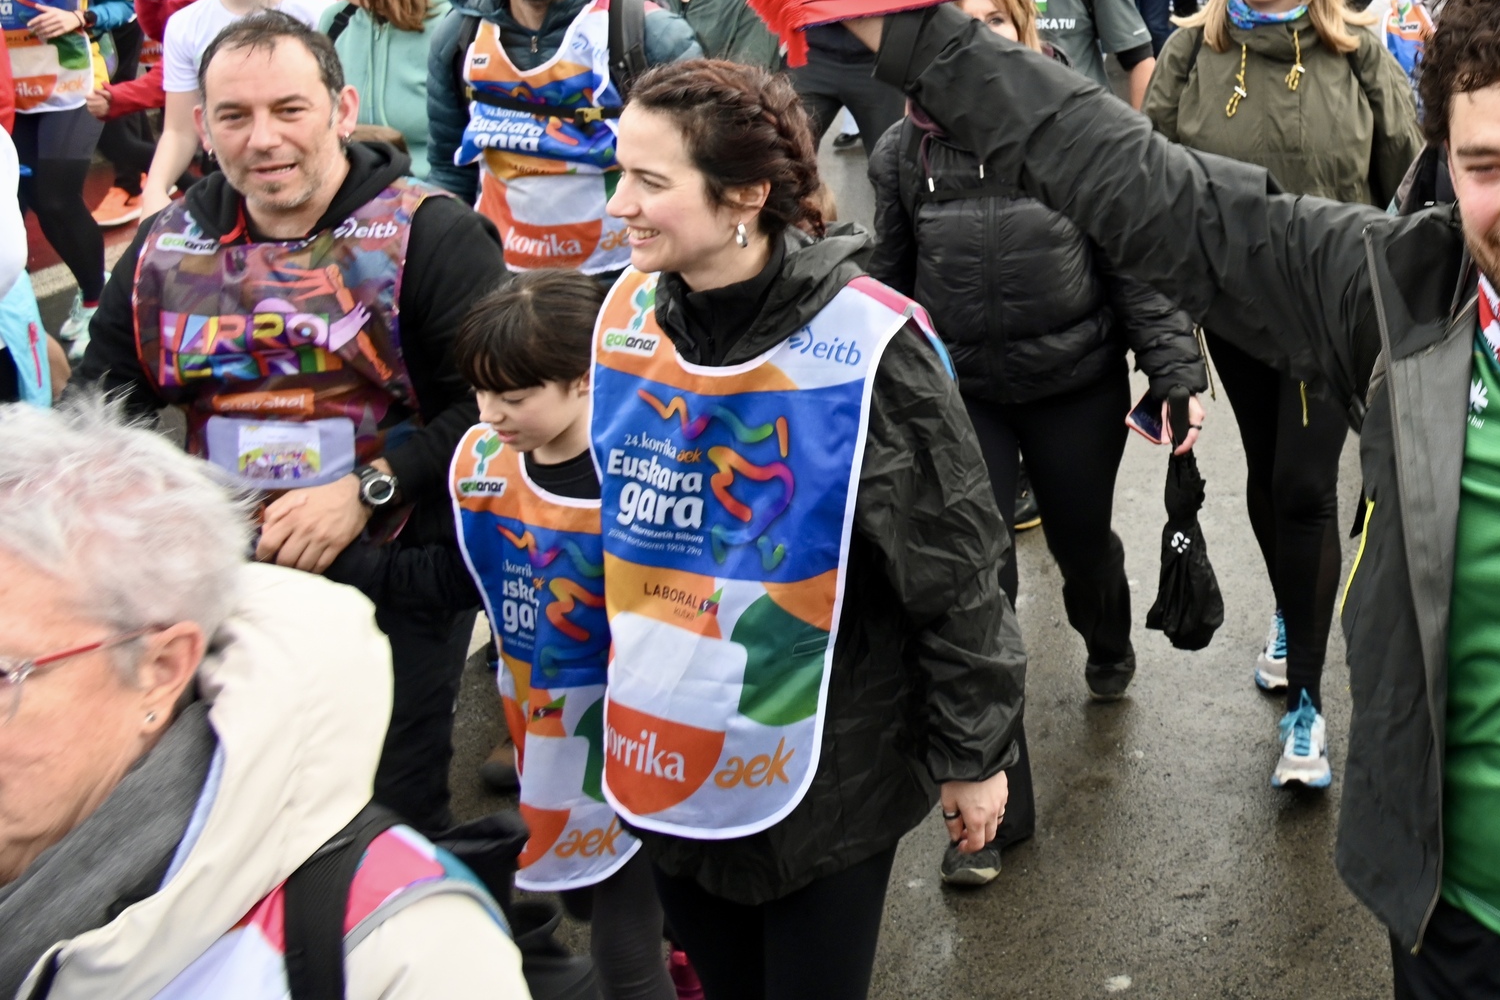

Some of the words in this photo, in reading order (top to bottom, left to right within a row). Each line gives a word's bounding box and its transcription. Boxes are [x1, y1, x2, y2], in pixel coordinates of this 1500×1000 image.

[468, 114, 544, 137] Euskara
[356, 219, 398, 240] eitb
[503, 226, 583, 258] korrika
[600, 228, 629, 251] ae
[812, 337, 862, 366] eitb
[676, 447, 703, 463] aek
[607, 448, 704, 493] Euskara
[616, 482, 705, 530] gara
[643, 581, 698, 609] LABORAL
[607, 724, 686, 783] orrika
[714, 736, 796, 790] aek
[554, 815, 624, 858] aek
